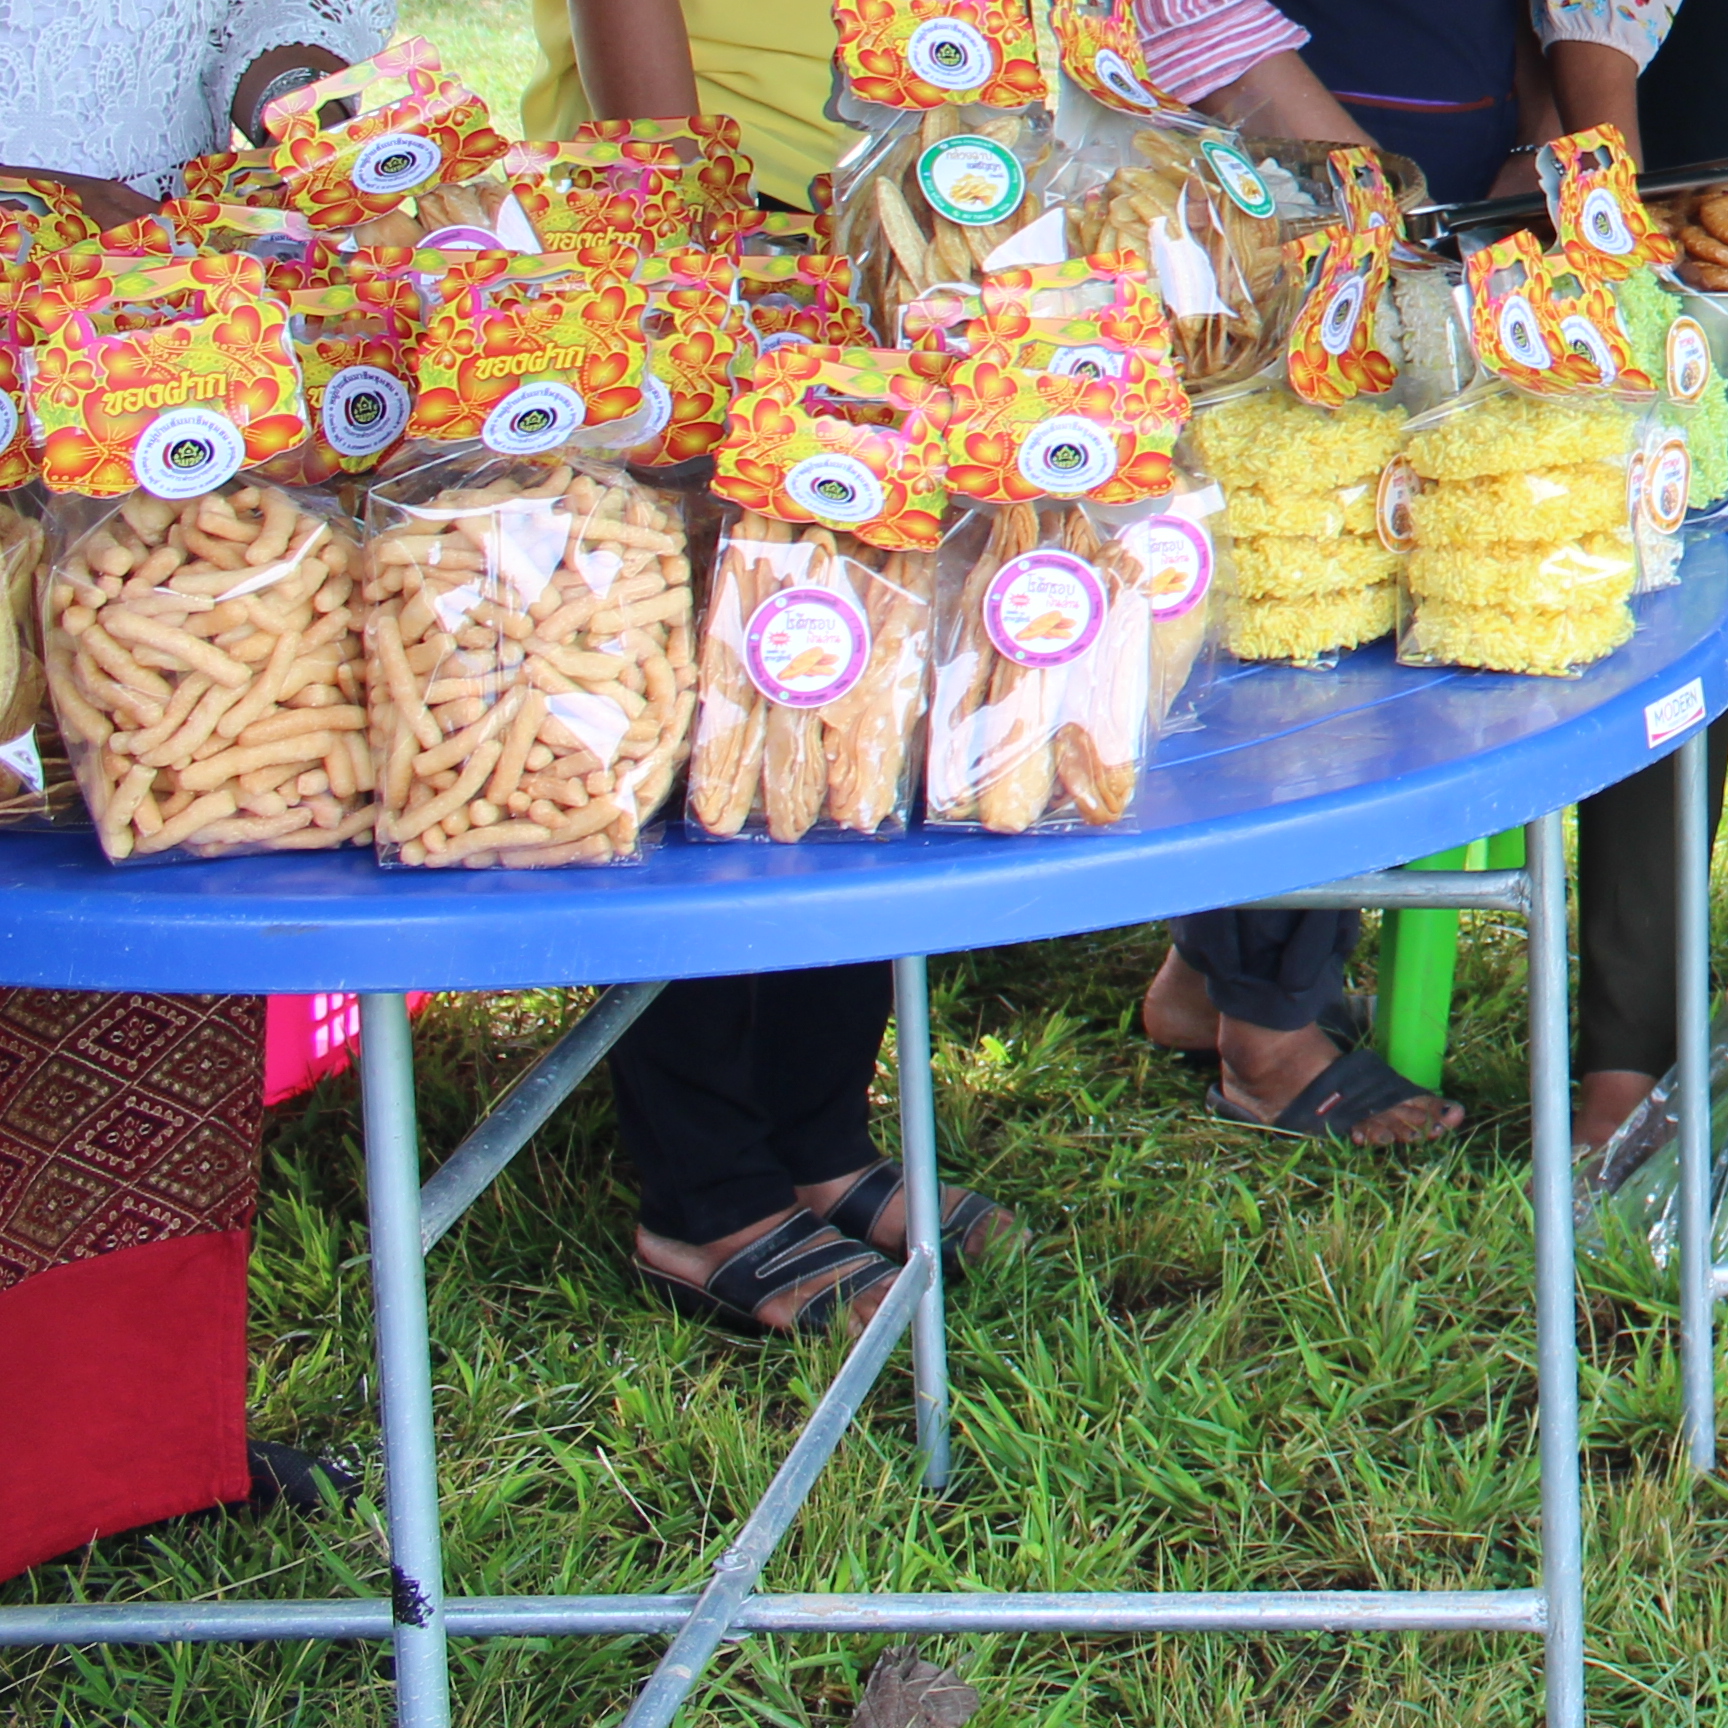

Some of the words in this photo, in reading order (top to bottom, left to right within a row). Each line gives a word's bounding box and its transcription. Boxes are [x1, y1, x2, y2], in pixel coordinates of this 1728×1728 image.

[545, 225, 642, 251] ของฝาก
[474, 342, 587, 381] ของฝาก
[102, 370, 228, 416] ของฝาก
[1653, 686, 1699, 727] MODERN
